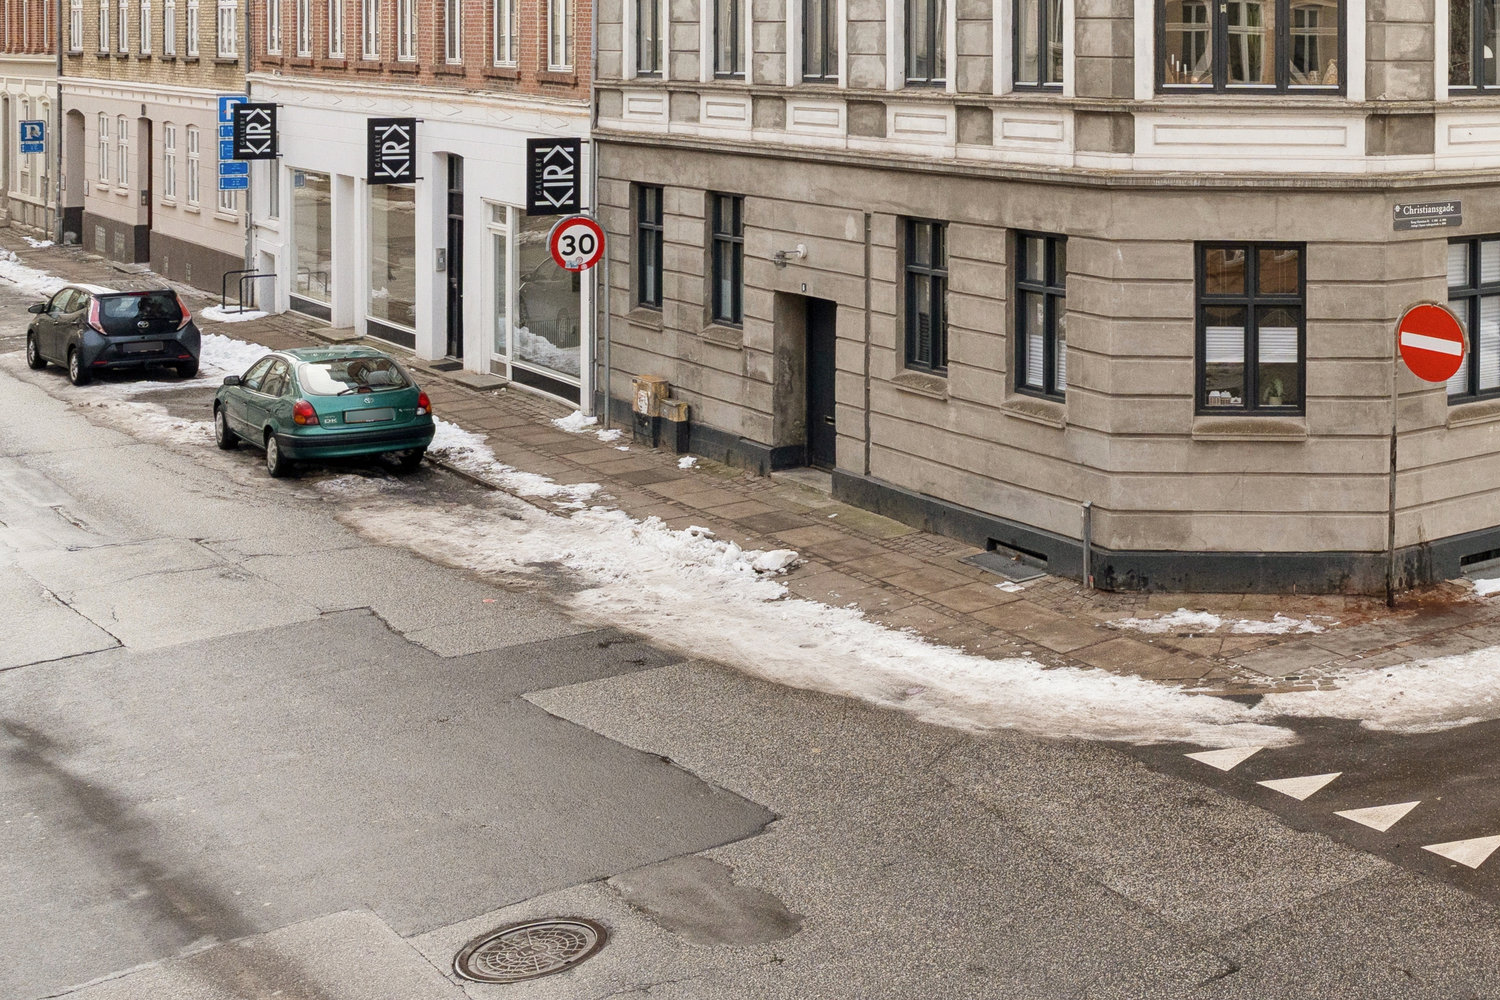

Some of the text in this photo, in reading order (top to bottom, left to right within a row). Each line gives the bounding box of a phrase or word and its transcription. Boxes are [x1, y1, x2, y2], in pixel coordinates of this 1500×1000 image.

[239, 108, 271, 154] KIRK
[374, 124, 410, 178] KIRK
[535, 145, 574, 208] KIRK
[1403, 203, 1455, 215] Christiansgade
[561, 233, 595, 256] 30
